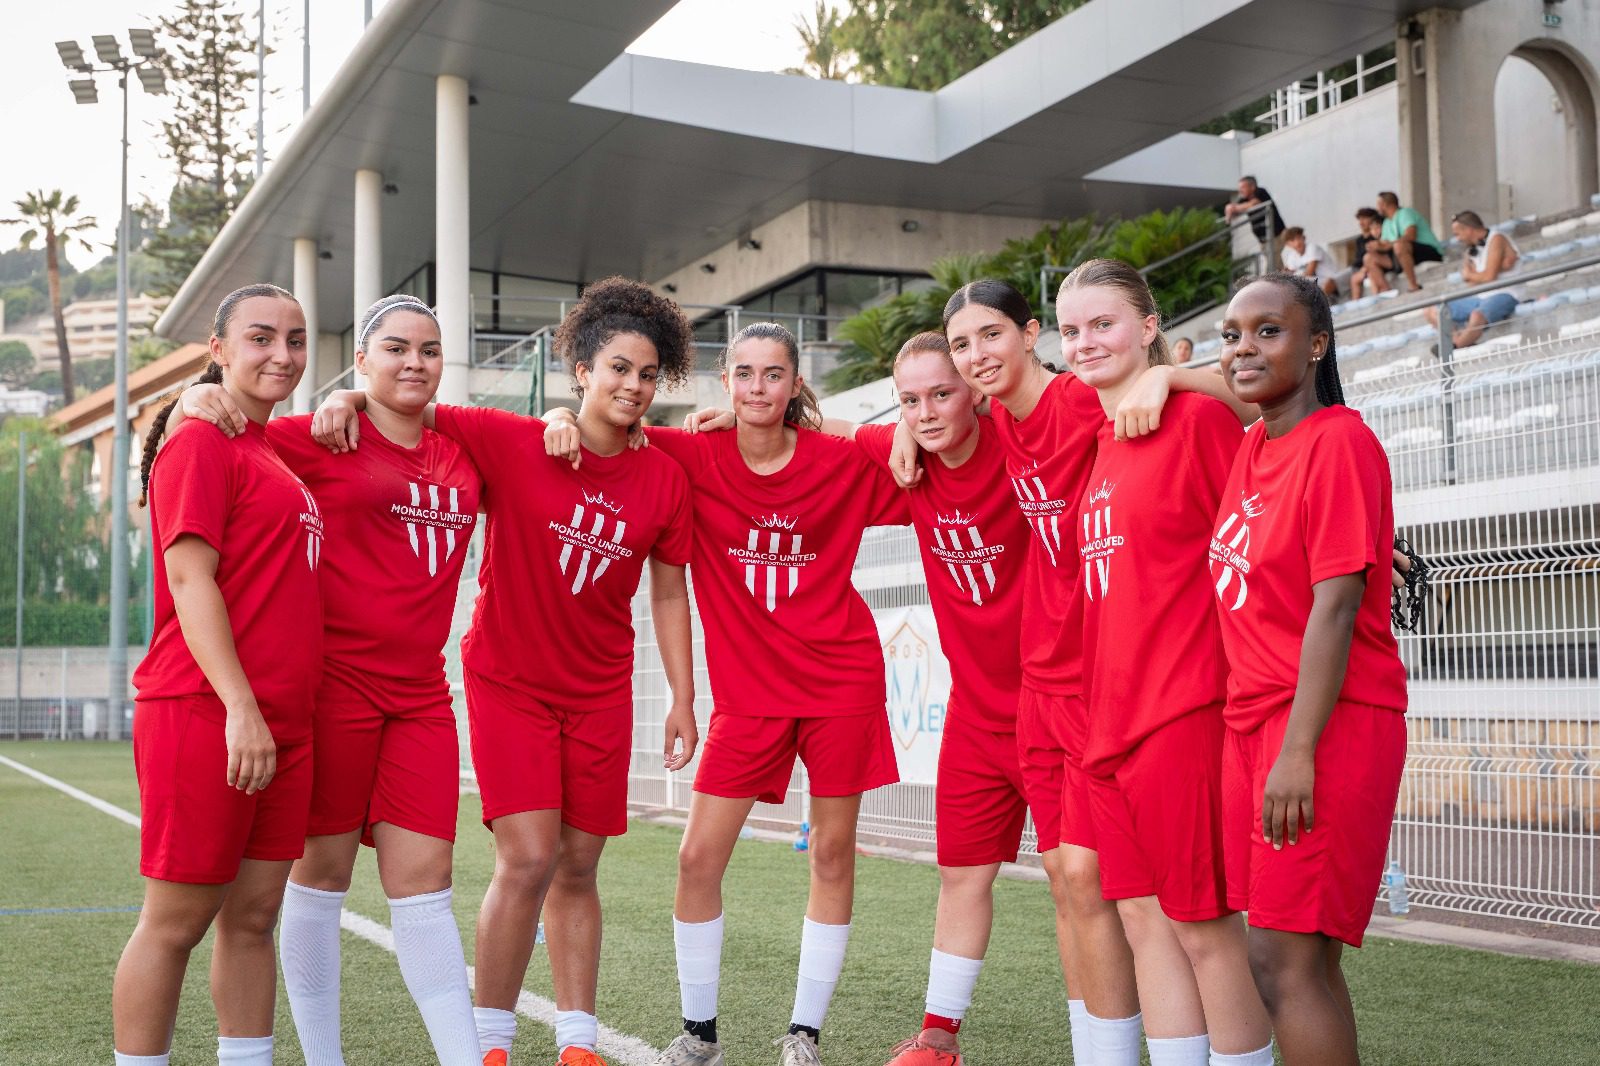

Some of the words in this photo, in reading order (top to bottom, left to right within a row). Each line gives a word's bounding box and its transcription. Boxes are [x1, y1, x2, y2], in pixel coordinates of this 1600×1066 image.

[391, 503, 438, 520] MONACO
[439, 511, 473, 524] UNITED
[425, 520, 450, 528] FOOTBALL
[548, 520, 597, 545] MONACO
[597, 538, 633, 558] UNITED
[581, 542, 607, 556] FOOTBALL
[728, 547, 777, 561] MONACO
[779, 552, 817, 562] UNITED
[930, 545, 966, 559] MONACO
[966, 544, 1005, 558] UNITED
[889, 644, 923, 659] ROS
